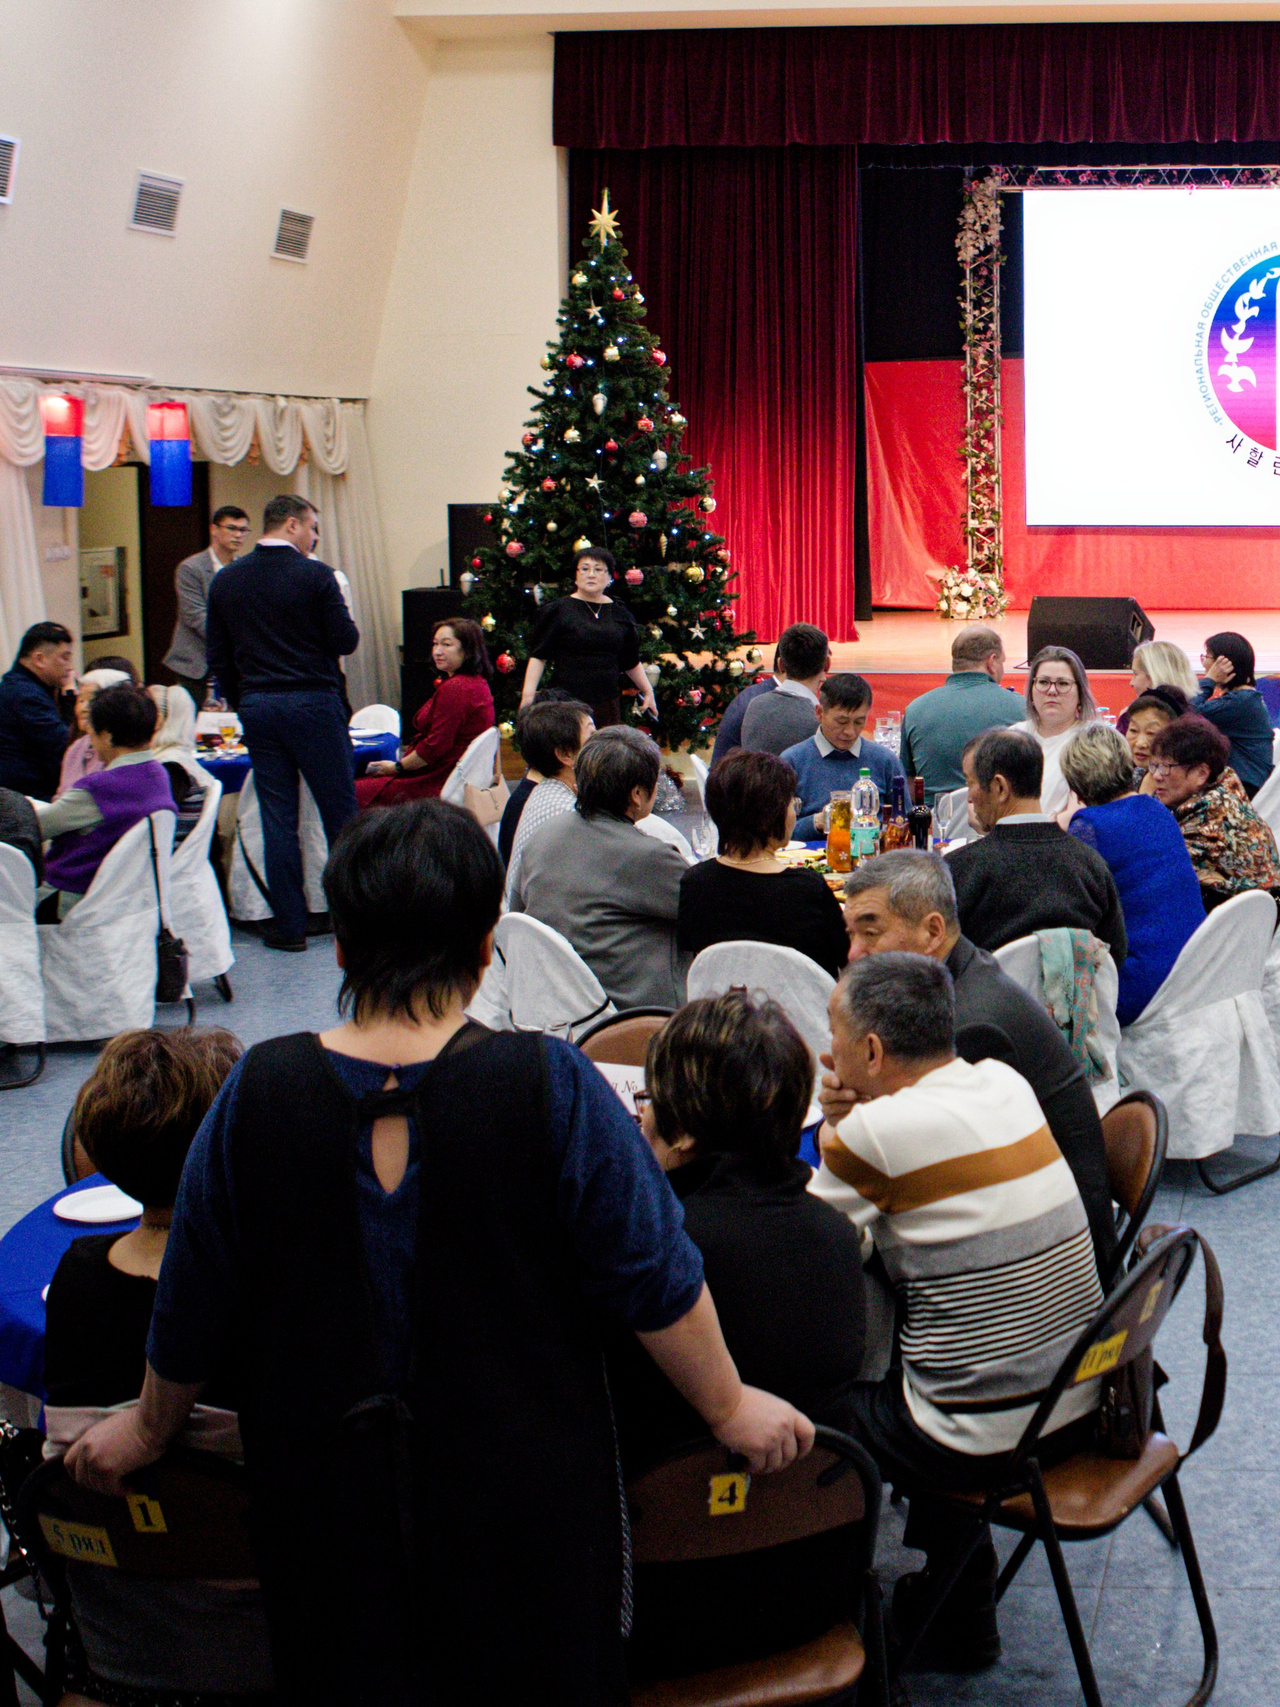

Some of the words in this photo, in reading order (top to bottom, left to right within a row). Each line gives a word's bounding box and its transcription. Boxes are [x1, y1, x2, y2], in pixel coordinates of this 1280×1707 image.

[1200, 241, 1278, 319] ОБЩЕСТВЕННАЯ
[1194, 321, 1223, 423] РЕГИОНАЛЬНАЯ
[137, 1502, 155, 1527] 1
[717, 1481, 738, 1506] 4
